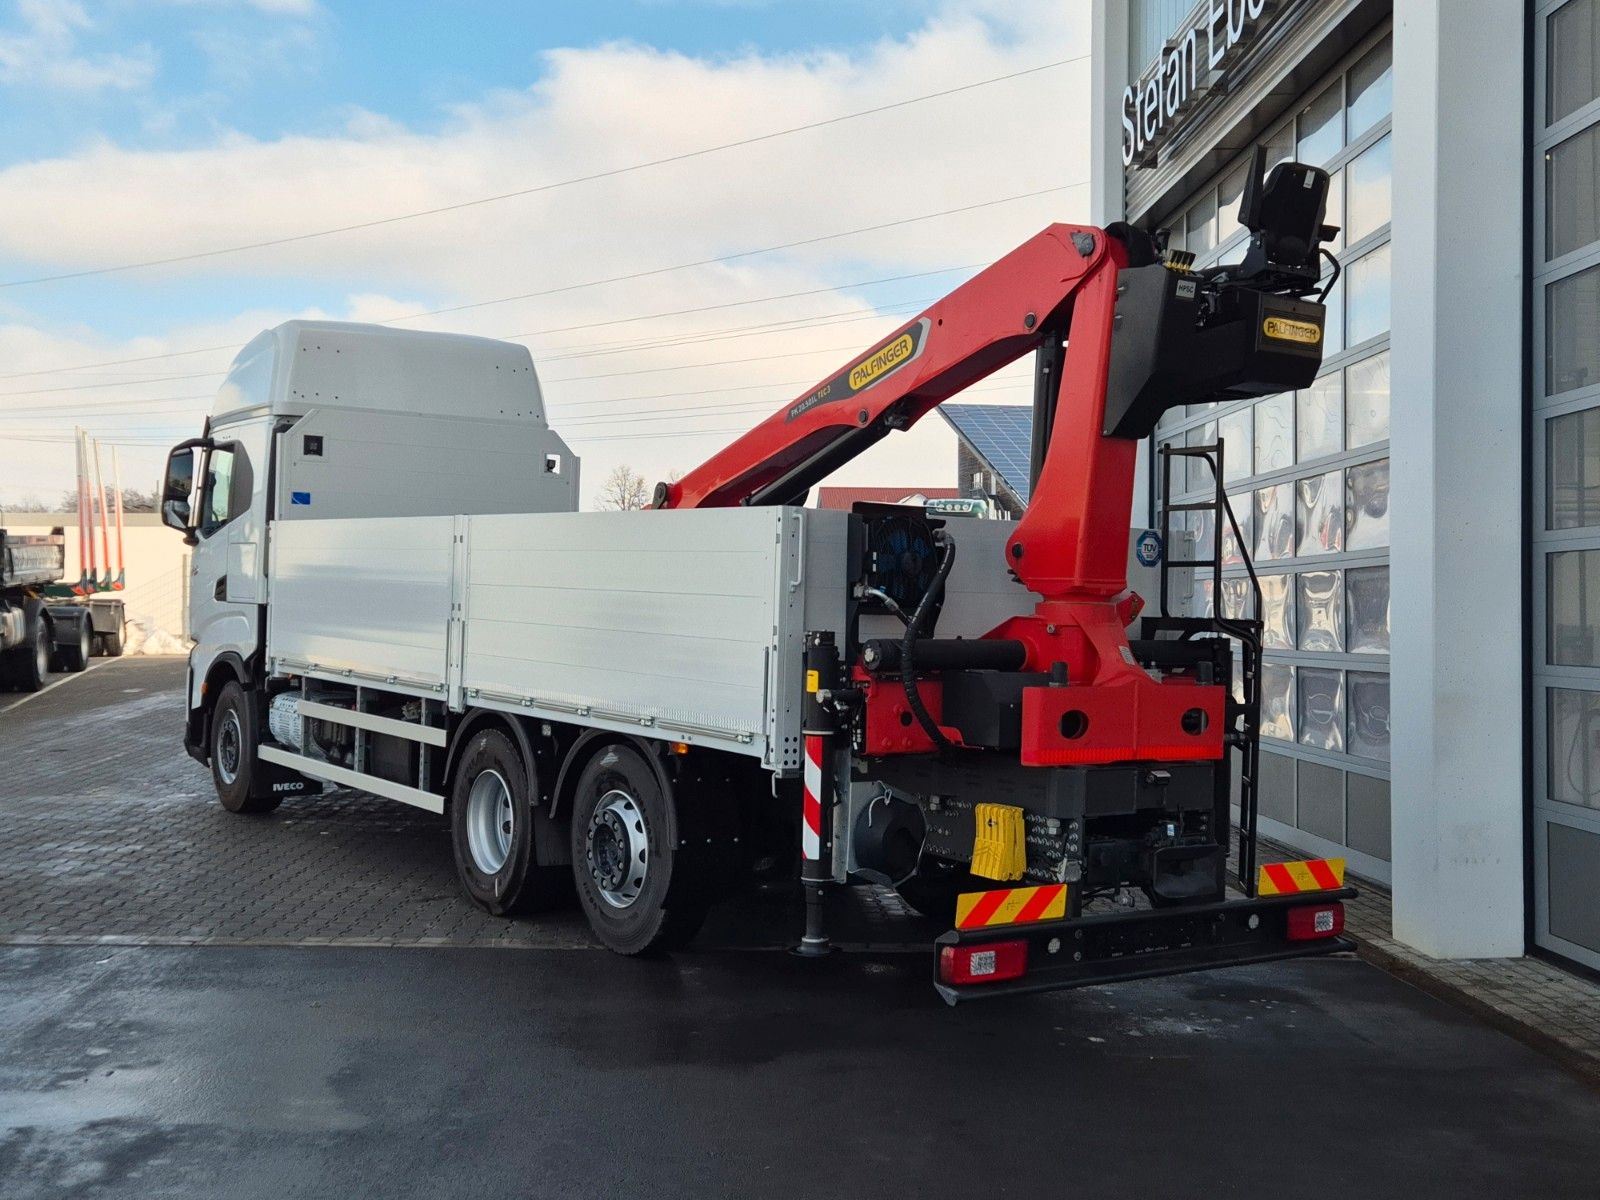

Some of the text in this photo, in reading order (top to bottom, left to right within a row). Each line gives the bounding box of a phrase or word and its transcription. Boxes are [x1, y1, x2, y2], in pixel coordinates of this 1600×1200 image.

[1122, 0, 1265, 166] Stefan Eb
[1178, 284, 1194, 294] HPSC
[1267, 321, 1317, 340] PALFINGER
[853, 339, 909, 386] PALFINGER
[791, 408, 799, 417] PK
[272, 782, 304, 791] IVECO
